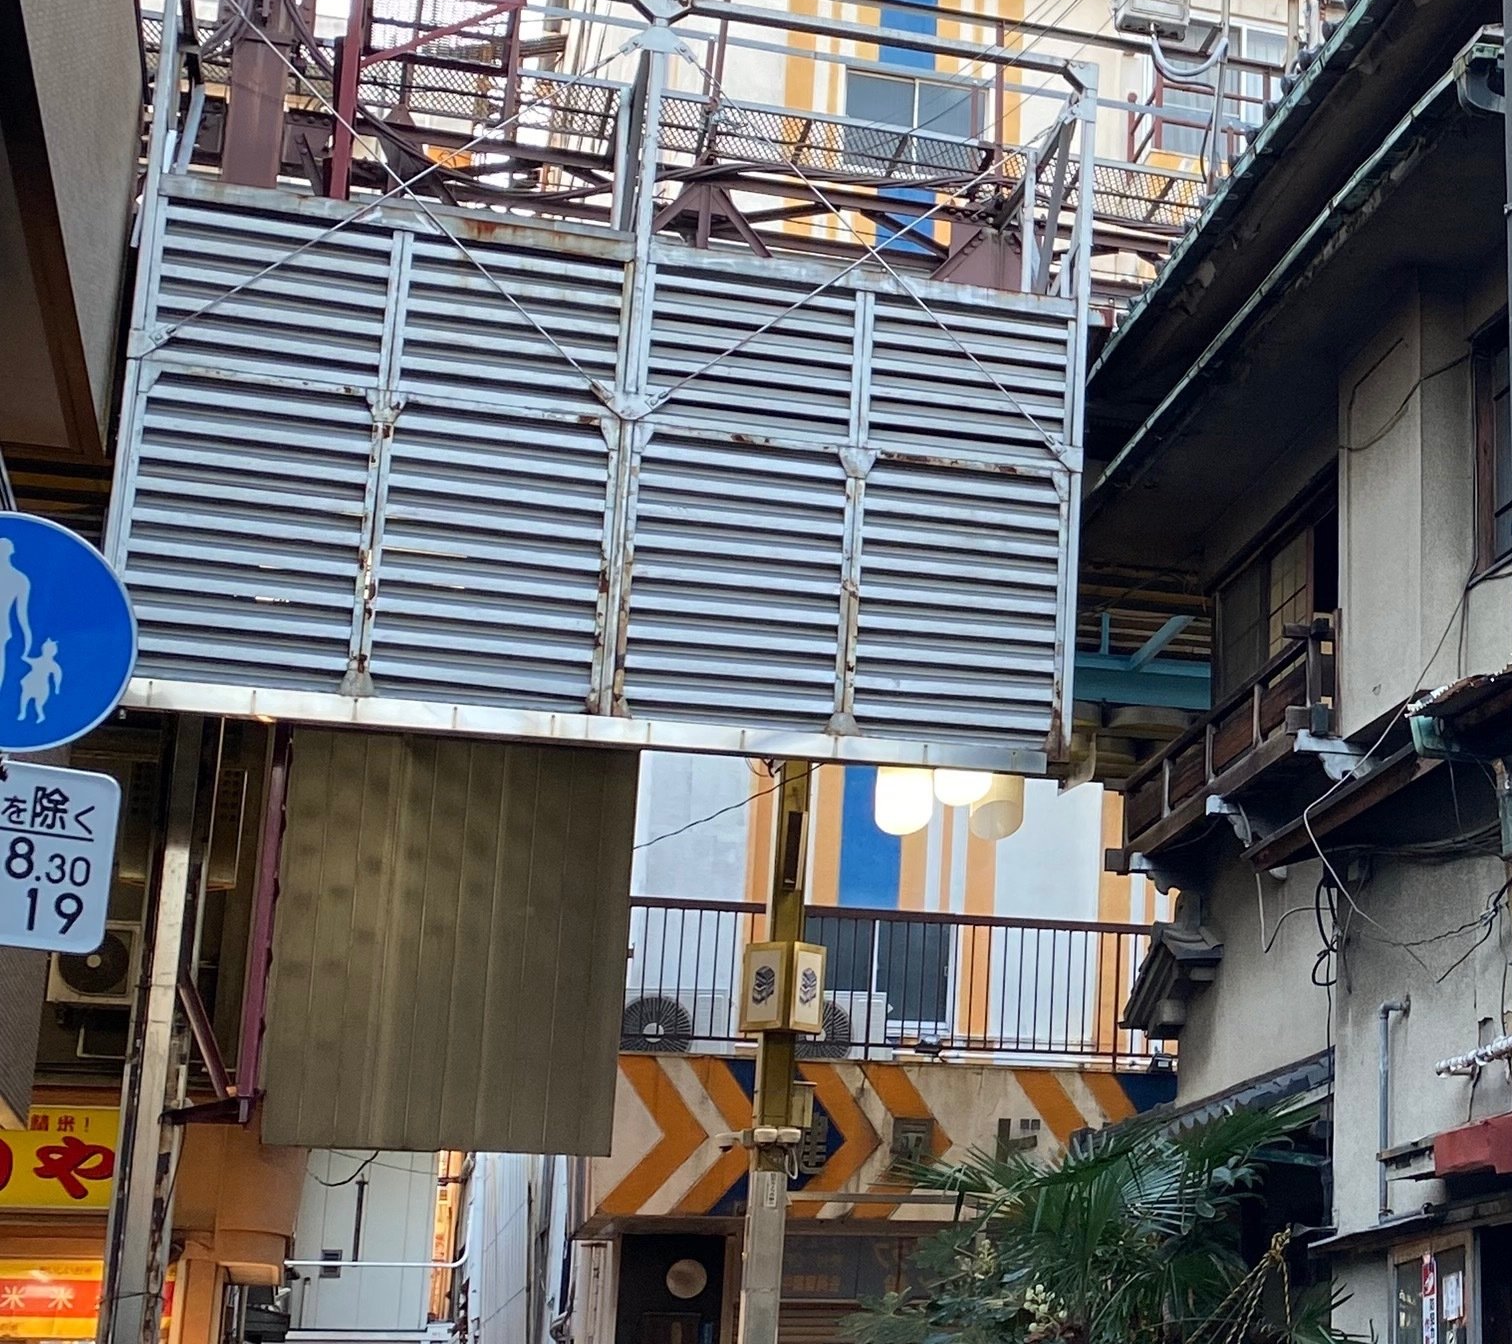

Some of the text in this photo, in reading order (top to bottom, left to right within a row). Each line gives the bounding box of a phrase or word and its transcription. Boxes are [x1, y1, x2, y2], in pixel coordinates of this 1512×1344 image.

[1, 785, 96, 835] を除く
[5, 836, 91, 887] 8.30
[26, 887, 84, 935] 19
